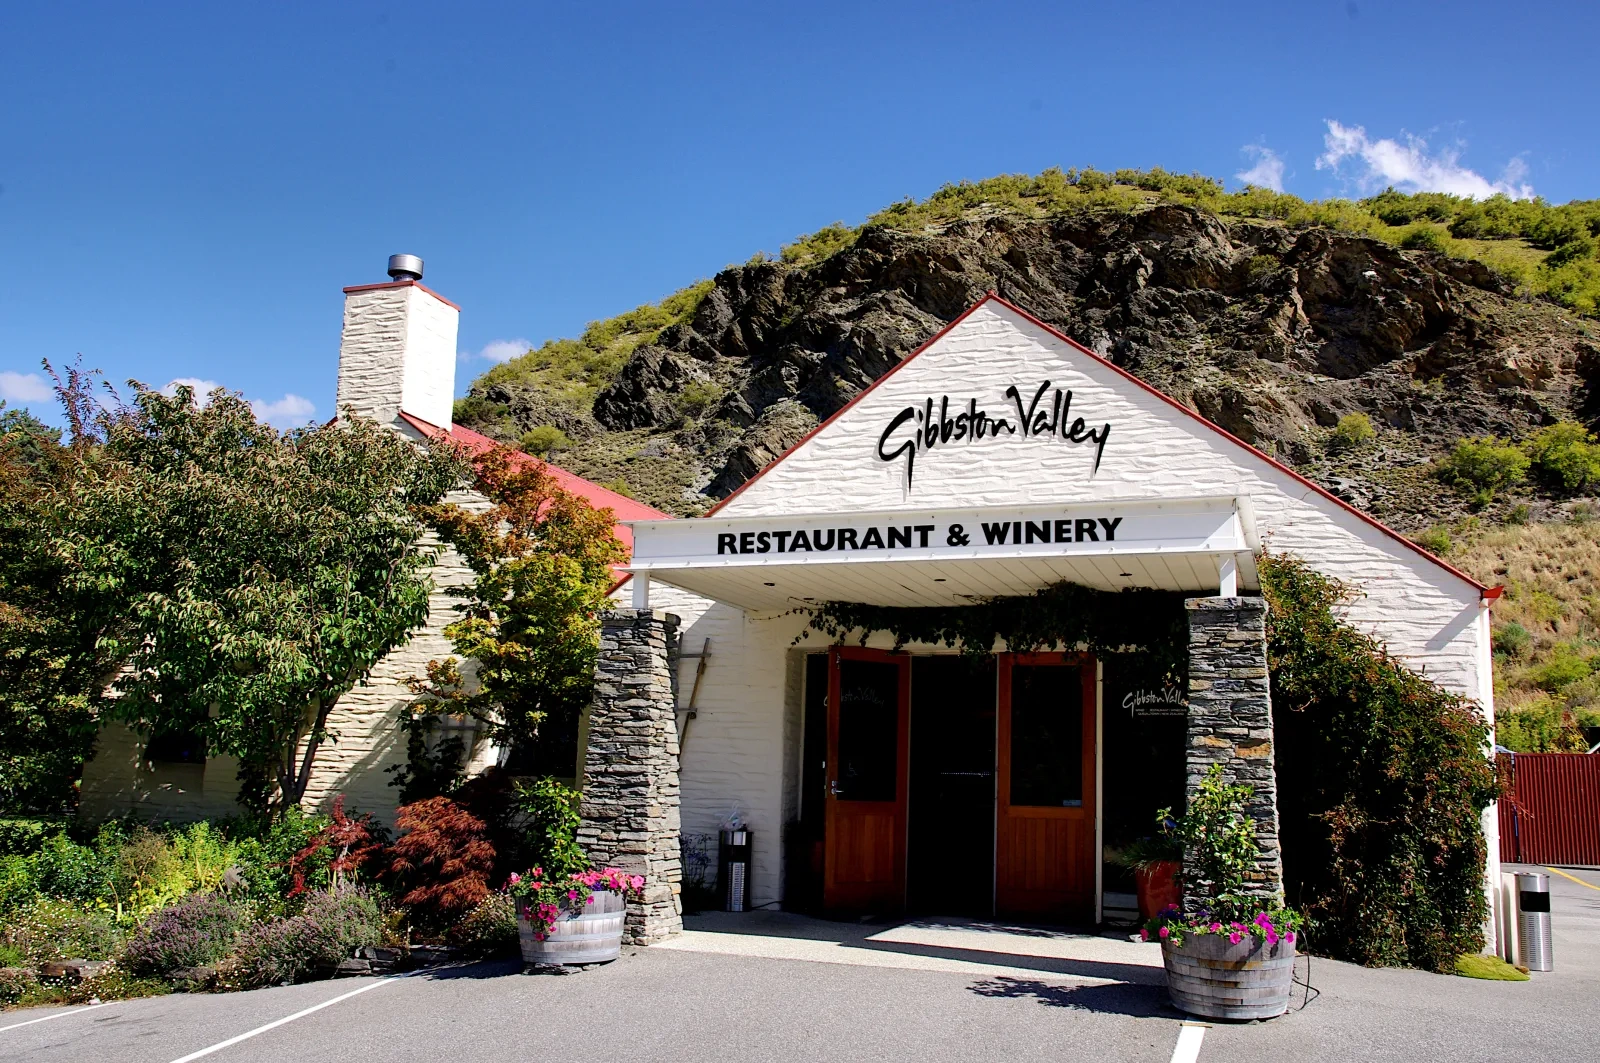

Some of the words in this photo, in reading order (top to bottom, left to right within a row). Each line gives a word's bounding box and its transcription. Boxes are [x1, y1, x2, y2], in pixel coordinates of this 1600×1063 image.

[878, 394, 1016, 495] Gibbston
[1005, 379, 1111, 476] Valley
[716, 524, 935, 555] RESTAURANT
[946, 523, 970, 547] &
[981, 517, 1123, 546] WINERY
[1122, 688, 1165, 719] Gibbston
[1161, 685, 1187, 706] Valle
